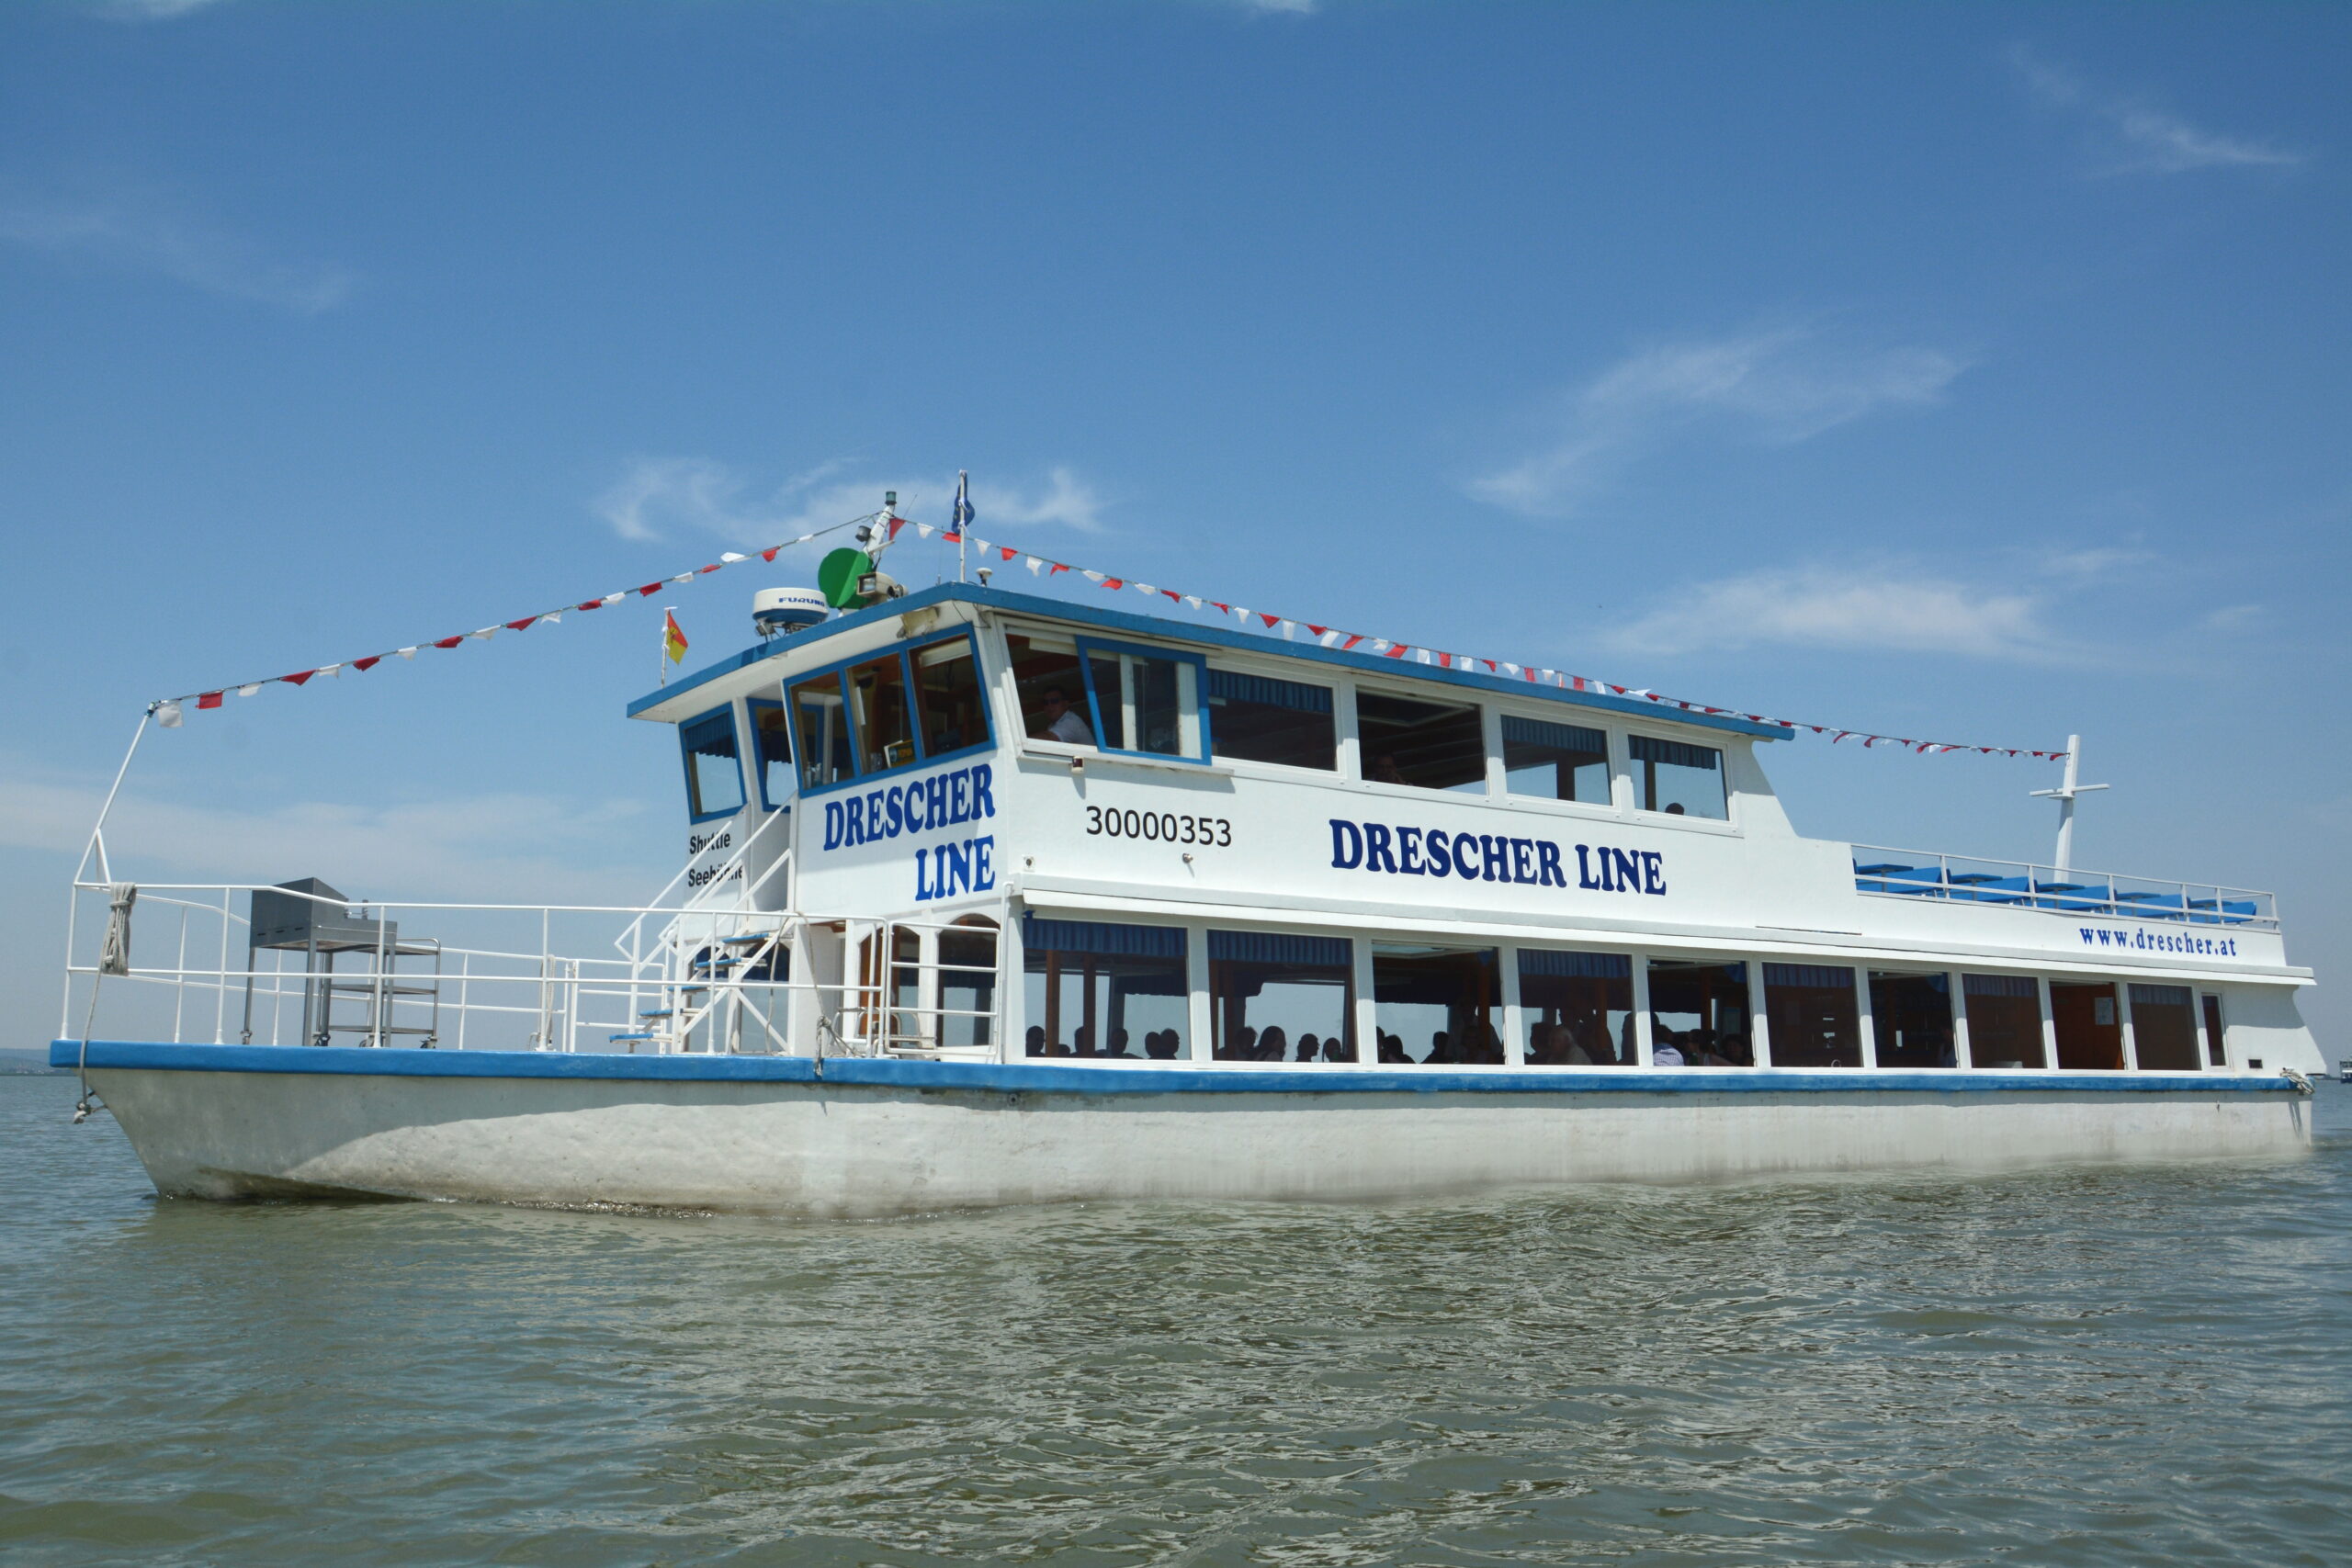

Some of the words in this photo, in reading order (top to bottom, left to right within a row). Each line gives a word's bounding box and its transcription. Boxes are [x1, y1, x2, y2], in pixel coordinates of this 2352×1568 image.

[824, 763, 996, 851] DRESCHER
[1086, 806, 1231, 847] 30000353
[915, 835, 996, 902] LINE
[1329, 818, 1566, 887] DRESCHER
[1575, 844, 1667, 896] LINE
[2079, 928, 2236, 956] www.drescher.at
